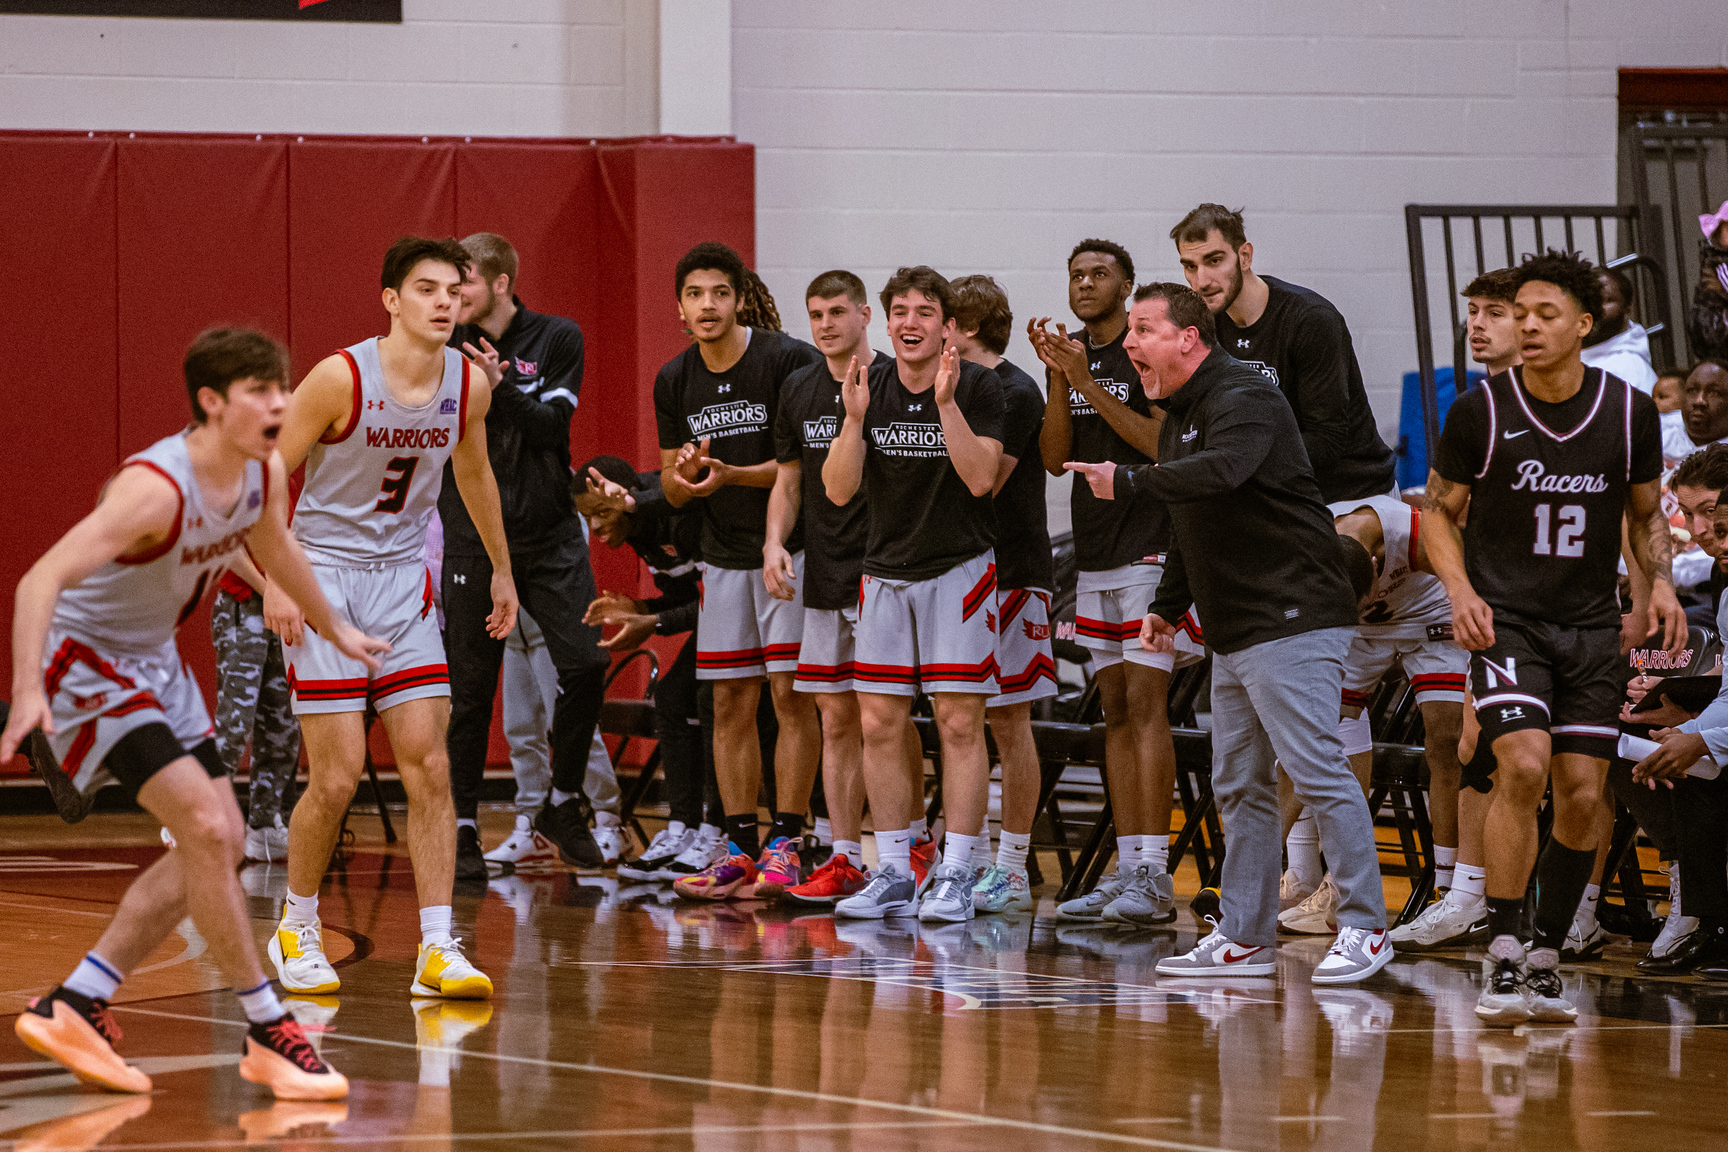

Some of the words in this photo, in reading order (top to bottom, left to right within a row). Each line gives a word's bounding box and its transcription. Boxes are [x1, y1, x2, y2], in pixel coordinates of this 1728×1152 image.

[690, 406, 765, 432] WARRIORS
[718, 425, 760, 438] BASKETBALL
[366, 427, 450, 449] WARRIORS
[874, 430, 947, 446] WARRIOR
[373, 456, 419, 514] 3
[1511, 459, 1609, 494] Racers
[1532, 503, 1586, 557] 12
